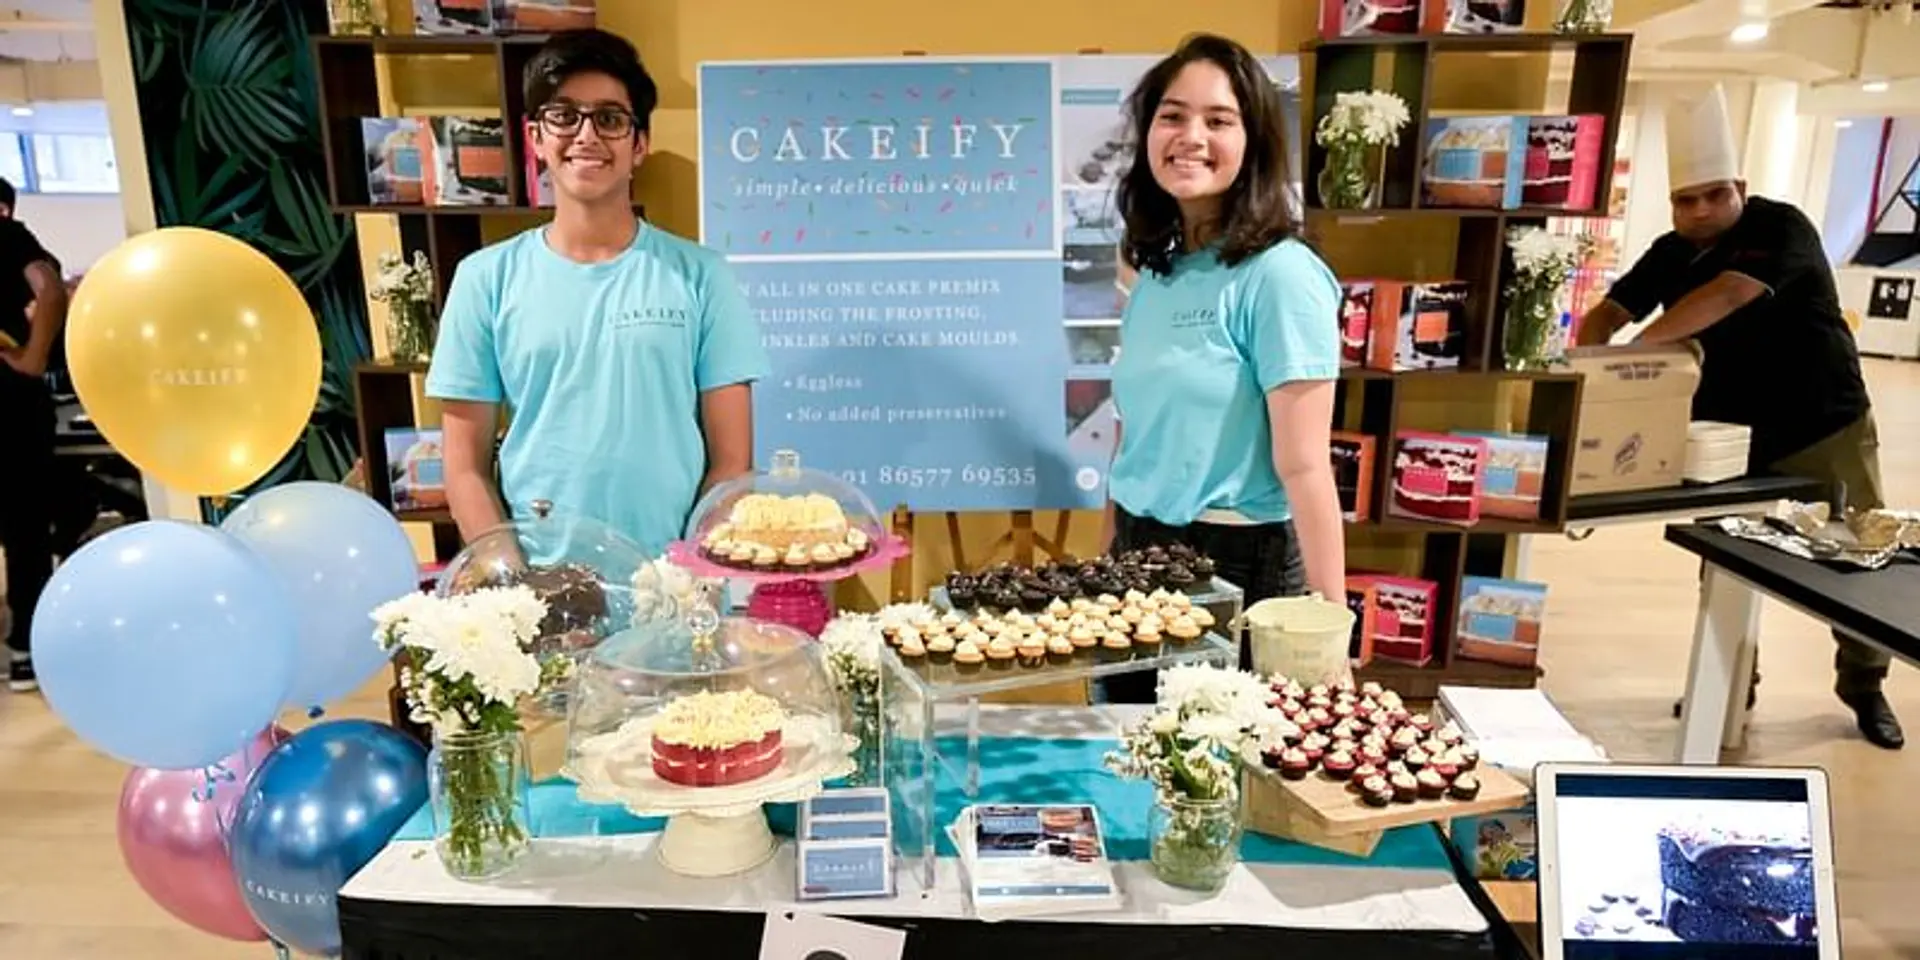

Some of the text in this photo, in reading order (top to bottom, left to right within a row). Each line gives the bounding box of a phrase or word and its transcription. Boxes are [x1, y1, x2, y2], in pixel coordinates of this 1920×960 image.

[729, 123, 1024, 162] CAKEIFY
[733, 173, 1020, 199] simple delicious quick
[756, 280, 793, 297] ALL
[798, 280, 820, 297] IN
[826, 279, 865, 297] ONE
[871, 279, 922, 296] CAKE
[928, 278, 1001, 295] PREMIX
[752, 306, 835, 324] LUDING
[840, 306, 881, 323] THE
[761, 332, 831, 348] INKLES
[838, 331, 877, 348] AND
[882, 331, 933, 347] CAKE
[797, 373, 864, 392] Eggless
[797, 402, 1008, 424] No added preservatives
[879, 463, 952, 488] 86577
[961, 462, 1037, 488] 69535
